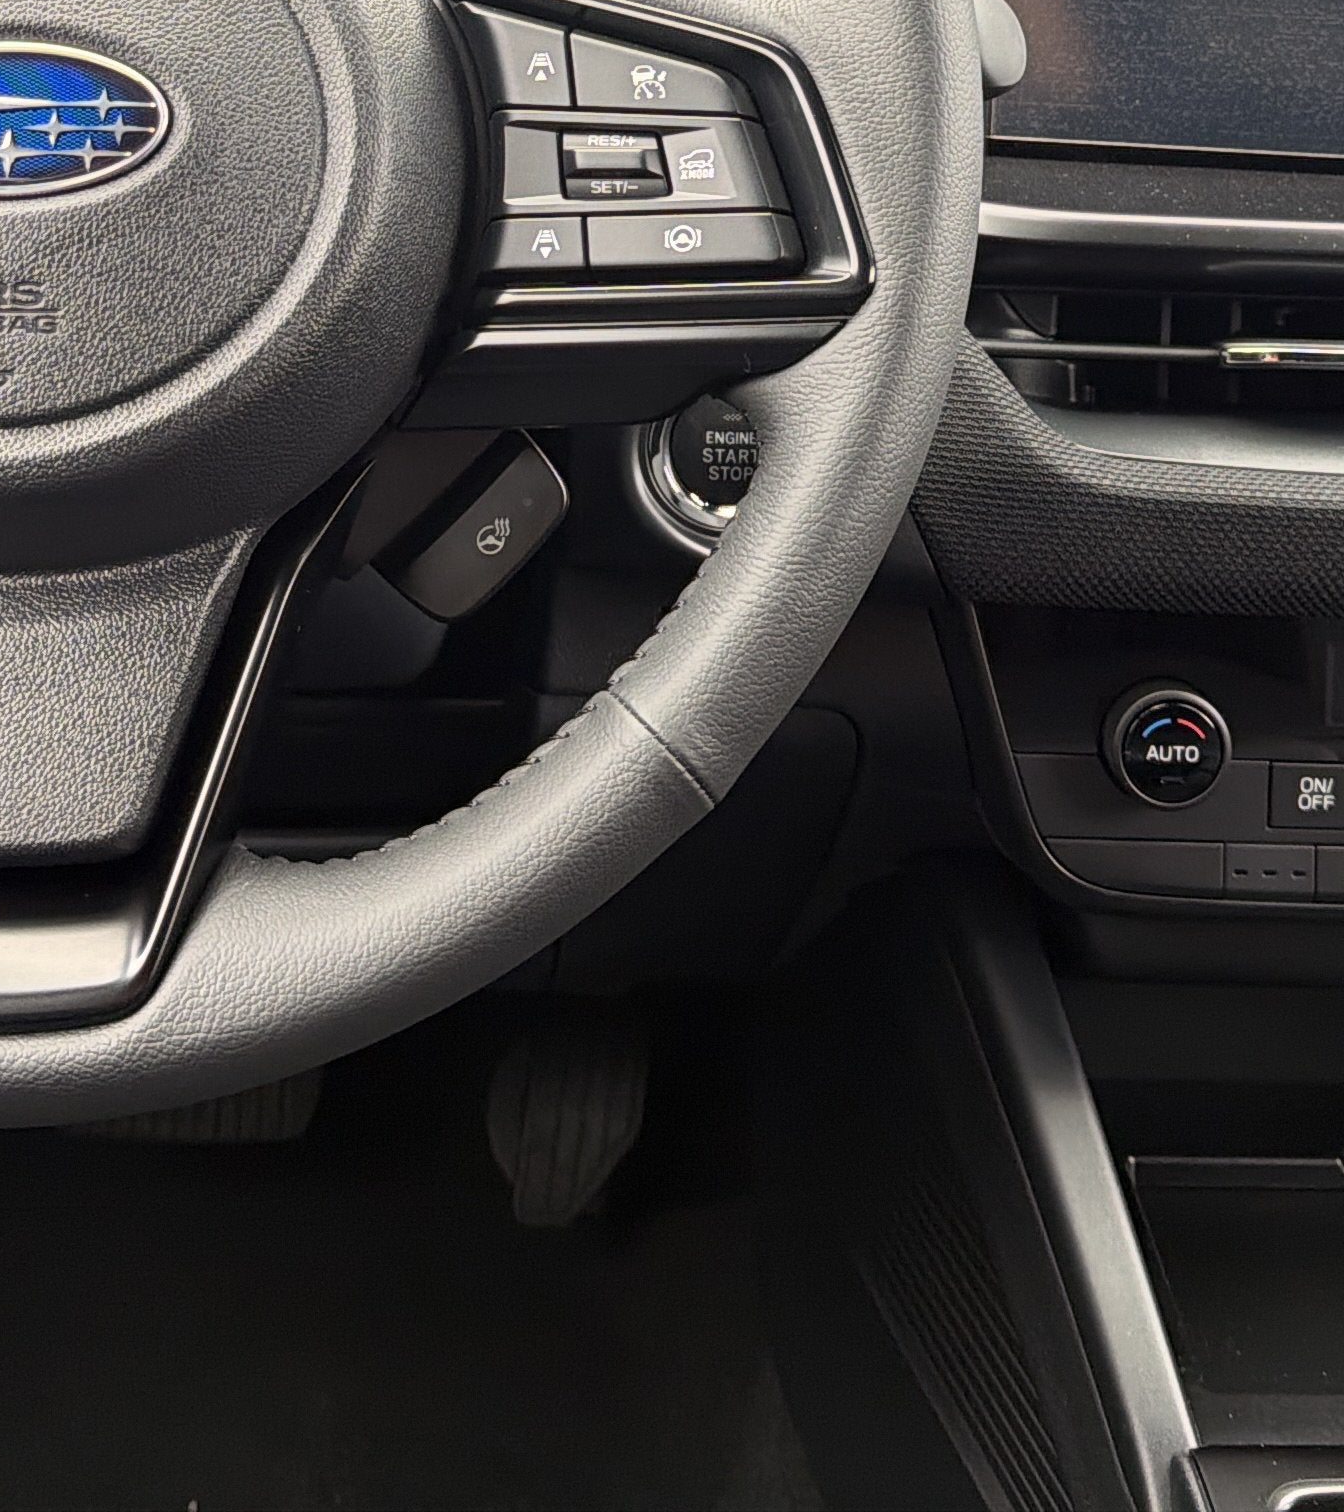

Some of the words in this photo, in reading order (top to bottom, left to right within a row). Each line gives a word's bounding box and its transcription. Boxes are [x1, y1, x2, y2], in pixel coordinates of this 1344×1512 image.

[705, 430, 757, 445] ENGINE
[702, 447, 757, 464] START
[708, 465, 754, 481] STOP
[1145, 744, 1200, 764] AUTO
[1299, 777, 1334, 794] ON/
[1297, 794, 1335, 811] OFF
